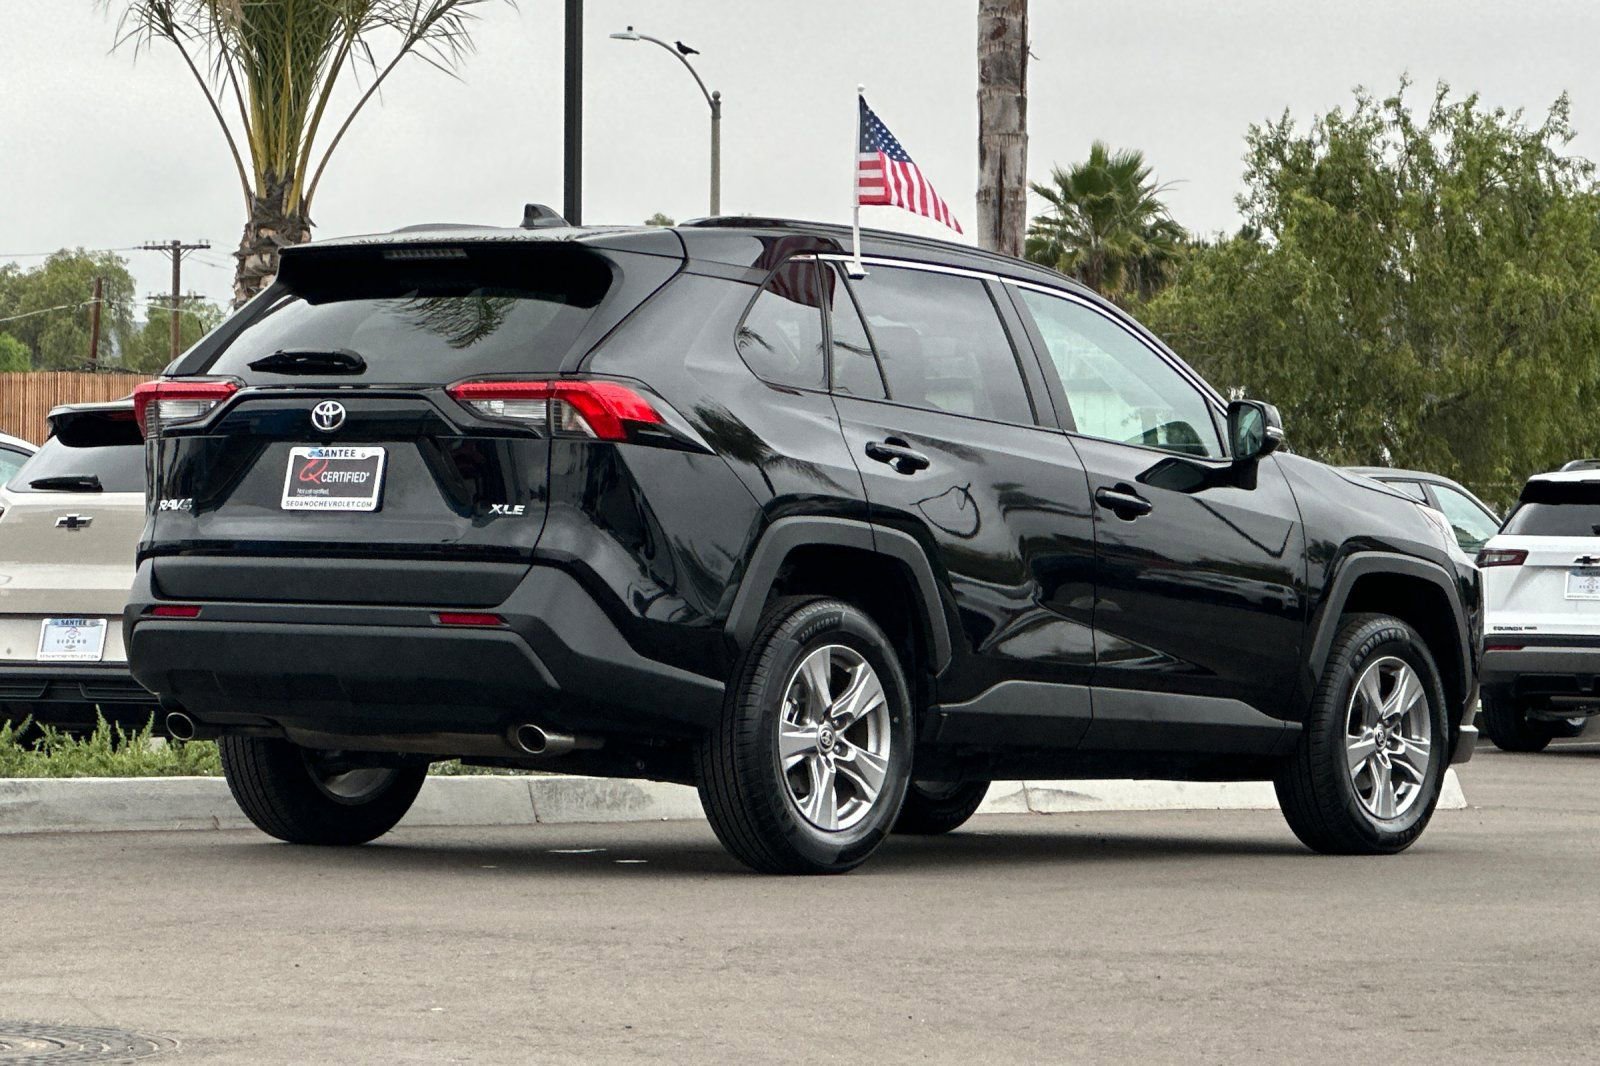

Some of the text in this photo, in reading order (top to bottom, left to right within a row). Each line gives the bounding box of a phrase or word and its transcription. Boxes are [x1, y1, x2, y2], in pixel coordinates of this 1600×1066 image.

[318, 449, 357, 458] SANTEE
[159, 498, 193, 510] RAV4
[488, 504, 526, 515] XLE
